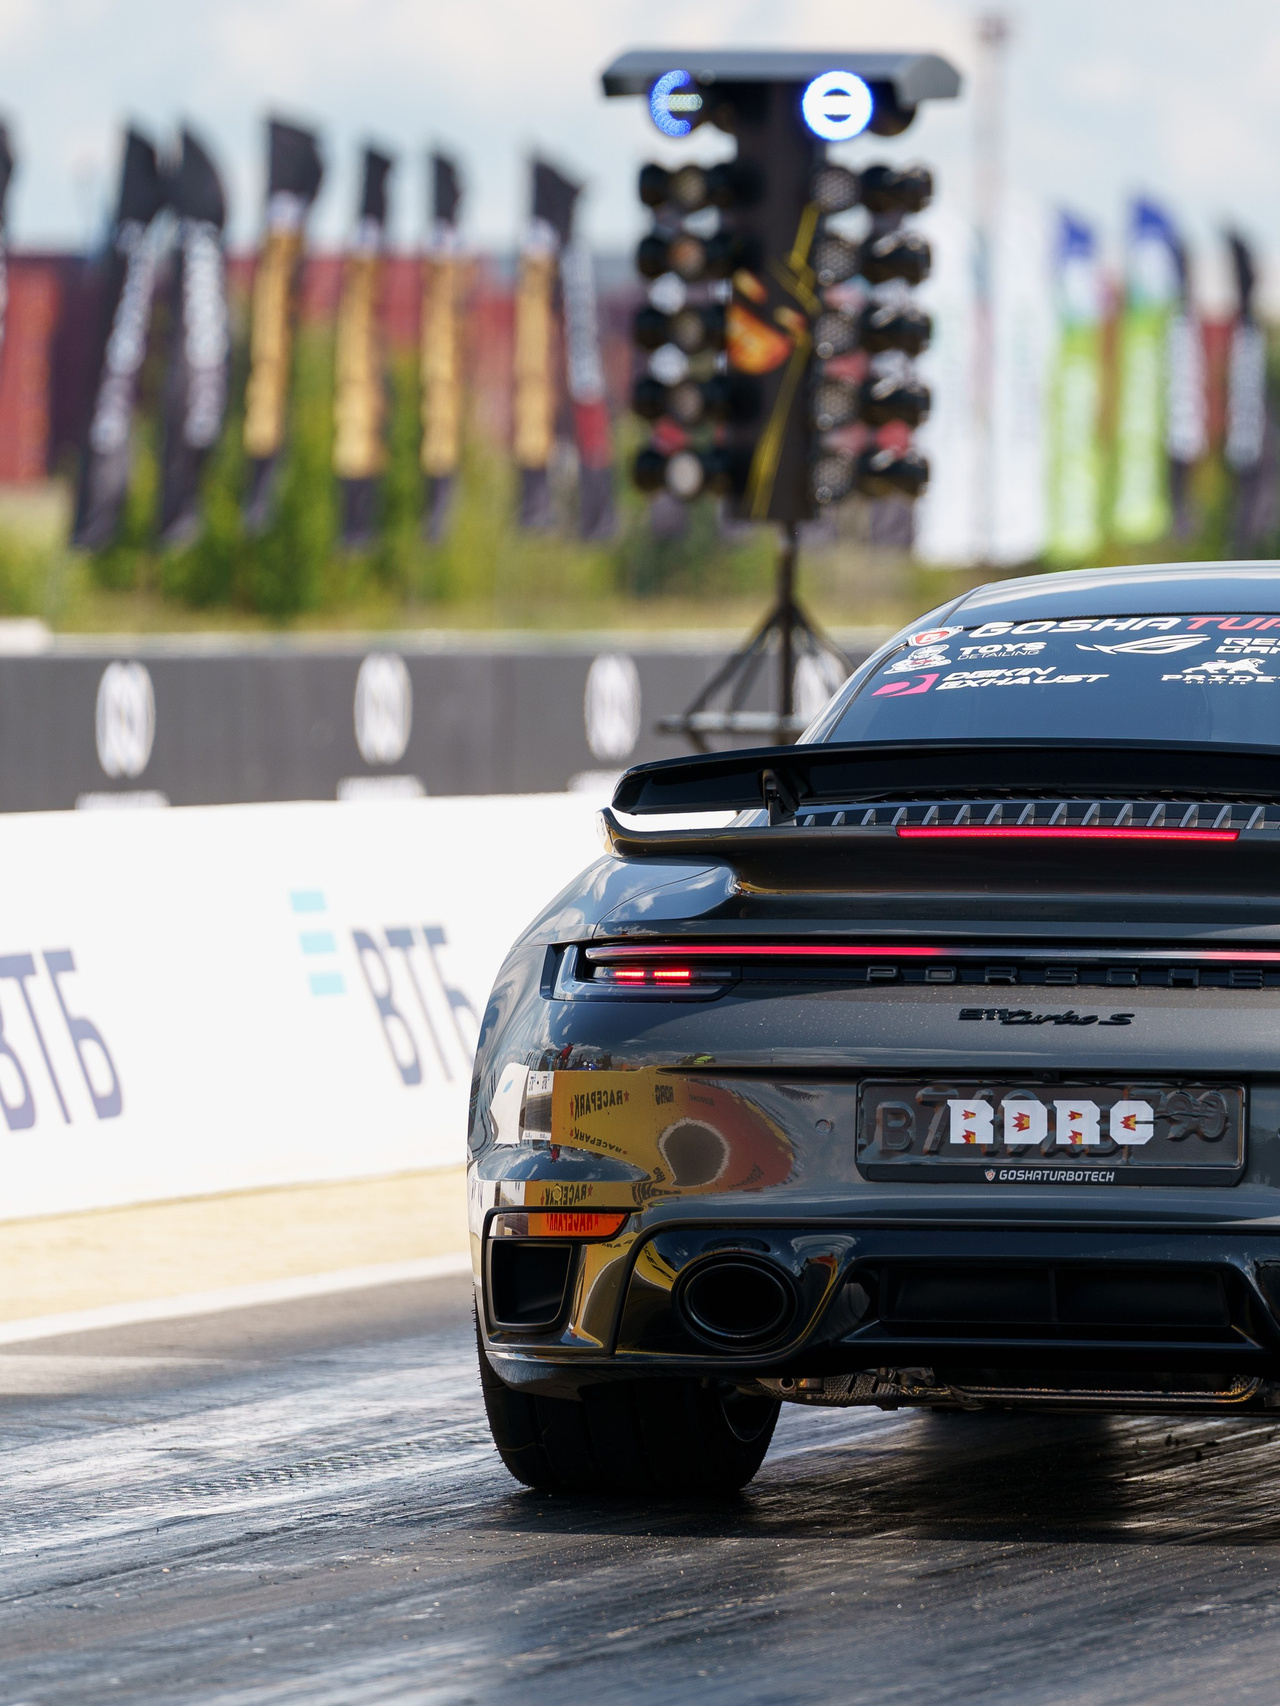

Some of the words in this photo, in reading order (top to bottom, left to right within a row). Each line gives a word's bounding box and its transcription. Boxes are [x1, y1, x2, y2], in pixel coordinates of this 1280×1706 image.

[958, 641, 1048, 655] TOYS
[956, 650, 1041, 661] DETAILING
[935, 674, 1110, 691] EXHAUST
[1161, 674, 1278, 683] PRIDE
[867, 964, 1265, 989] PORSCHE
[947, 1099, 1154, 1145] RDRC
[999, 1170, 1115, 1182] GOSHATURBOTECH
